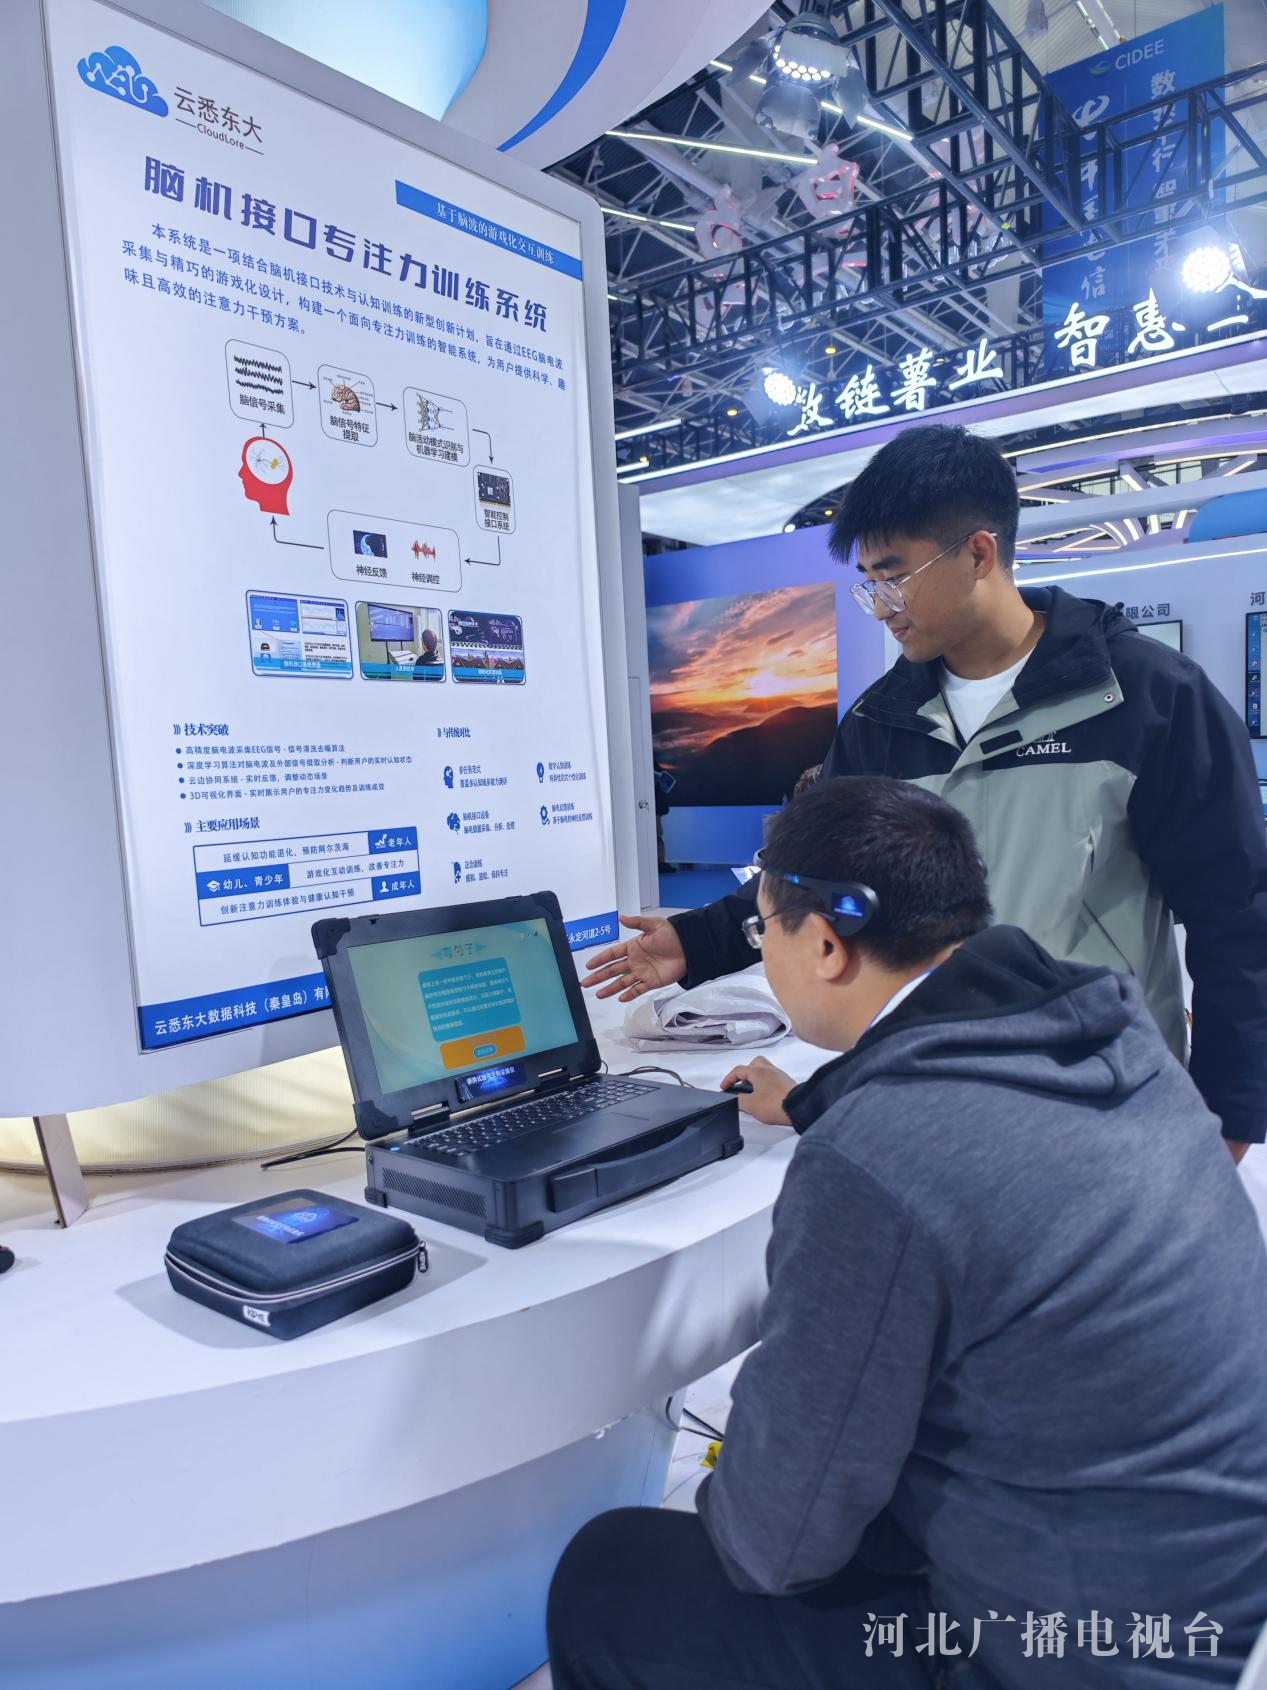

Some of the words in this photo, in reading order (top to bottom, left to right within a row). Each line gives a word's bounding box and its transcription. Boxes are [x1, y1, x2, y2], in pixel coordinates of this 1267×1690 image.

[1114, 38, 1166, 71] CIDEE
[173, 86, 263, 143] 云悉东大
[196, 123, 246, 150] CloudLore
[436, 201, 555, 265] 基于脑波的游戏化交互训练
[145, 155, 547, 333] 脑机接口专注力训练系统
[239, 393, 286, 416] 脑信号采集
[329, 415, 370, 434] 脑信号特征
[342, 428, 360, 443] 提取
[408, 431, 465, 454] 脑活动模式识别与
[416, 444, 459, 463] 机器学习建模
[483, 507, 509, 522] 智能控制
[484, 518, 510, 532] 接口系统
[356, 563, 388, 579] 神经反馈
[411, 571, 440, 585] 神经调控
[1250, 591, 1266, 607] 河
[183, 722, 230, 737] 技术突破
[1015, 742, 1072, 758] CAMEL
[195, 816, 260, 833] 主要应用场景
[388, 836, 412, 848] 老年人
[223, 872, 284, 891] 幼儿、青少年
[391, 879, 415, 892] 成年人
[565, 924, 612, 945] 永定河道2-5号
